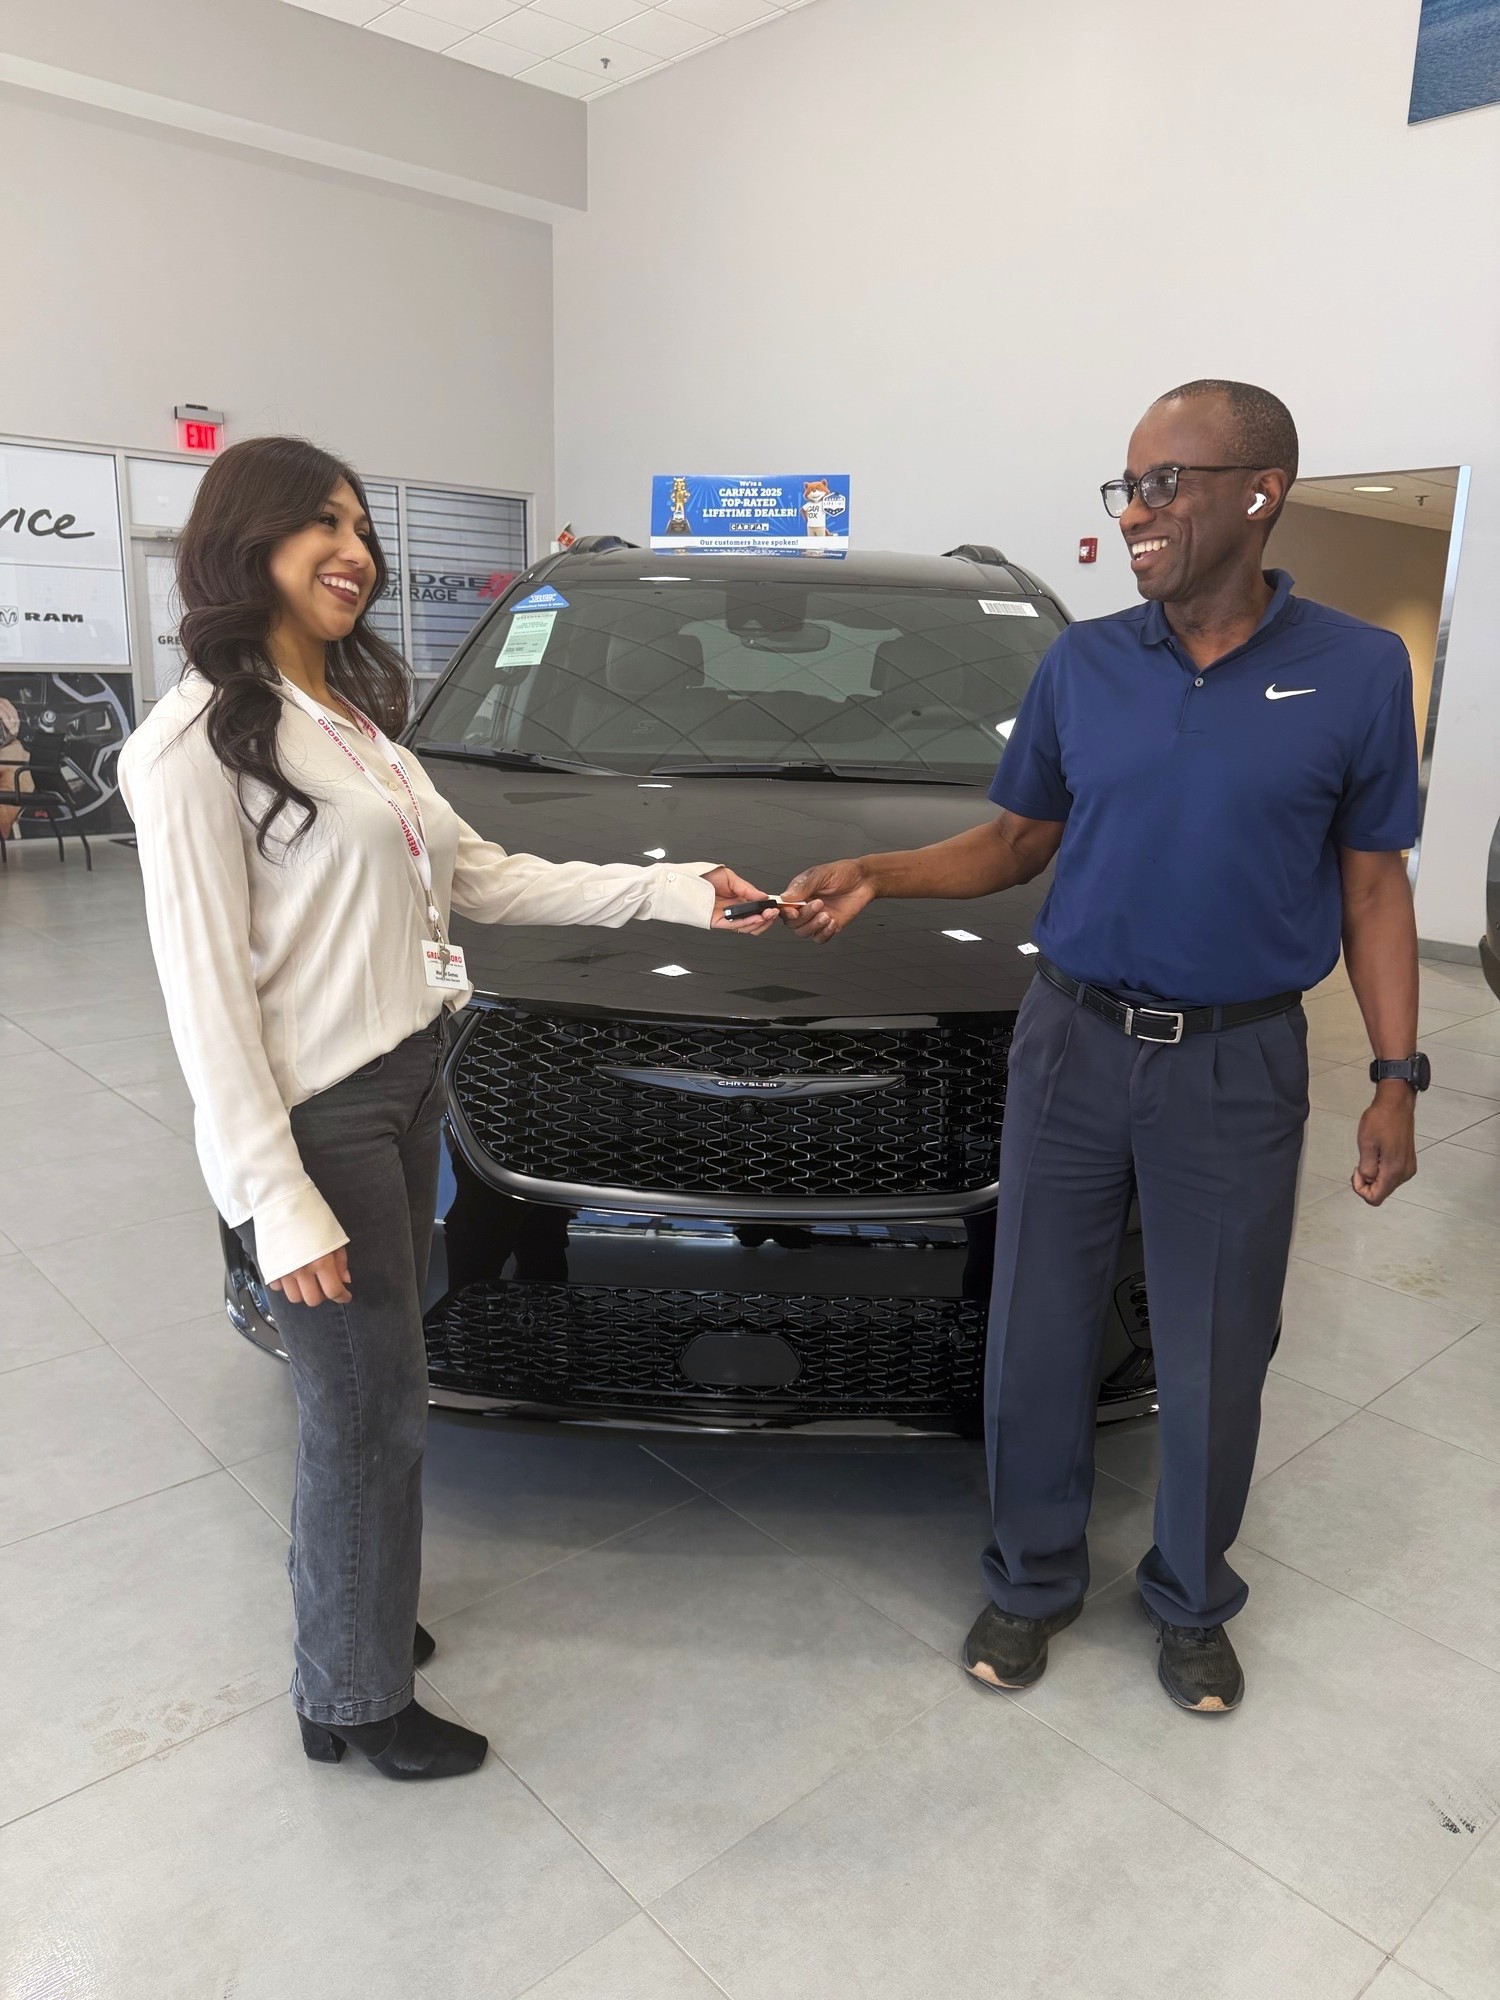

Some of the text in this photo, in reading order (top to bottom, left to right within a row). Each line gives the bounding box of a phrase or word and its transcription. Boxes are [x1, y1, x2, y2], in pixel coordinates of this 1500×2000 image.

[186, 423, 216, 450] EXIT
[718, 488, 783, 497] CARFAX 2025
[721, 498, 777, 507] TOP-RATED
[702, 508, 798, 518] LIFETIME DEALER!
[730, 523, 769, 532] CARFAX
[770, 539, 799, 547] spoken!
[25, 612, 84, 623] RAM
[317, 718, 366, 773] GREENSBORO
[717, 1080, 778, 1088] CHRYSLER
